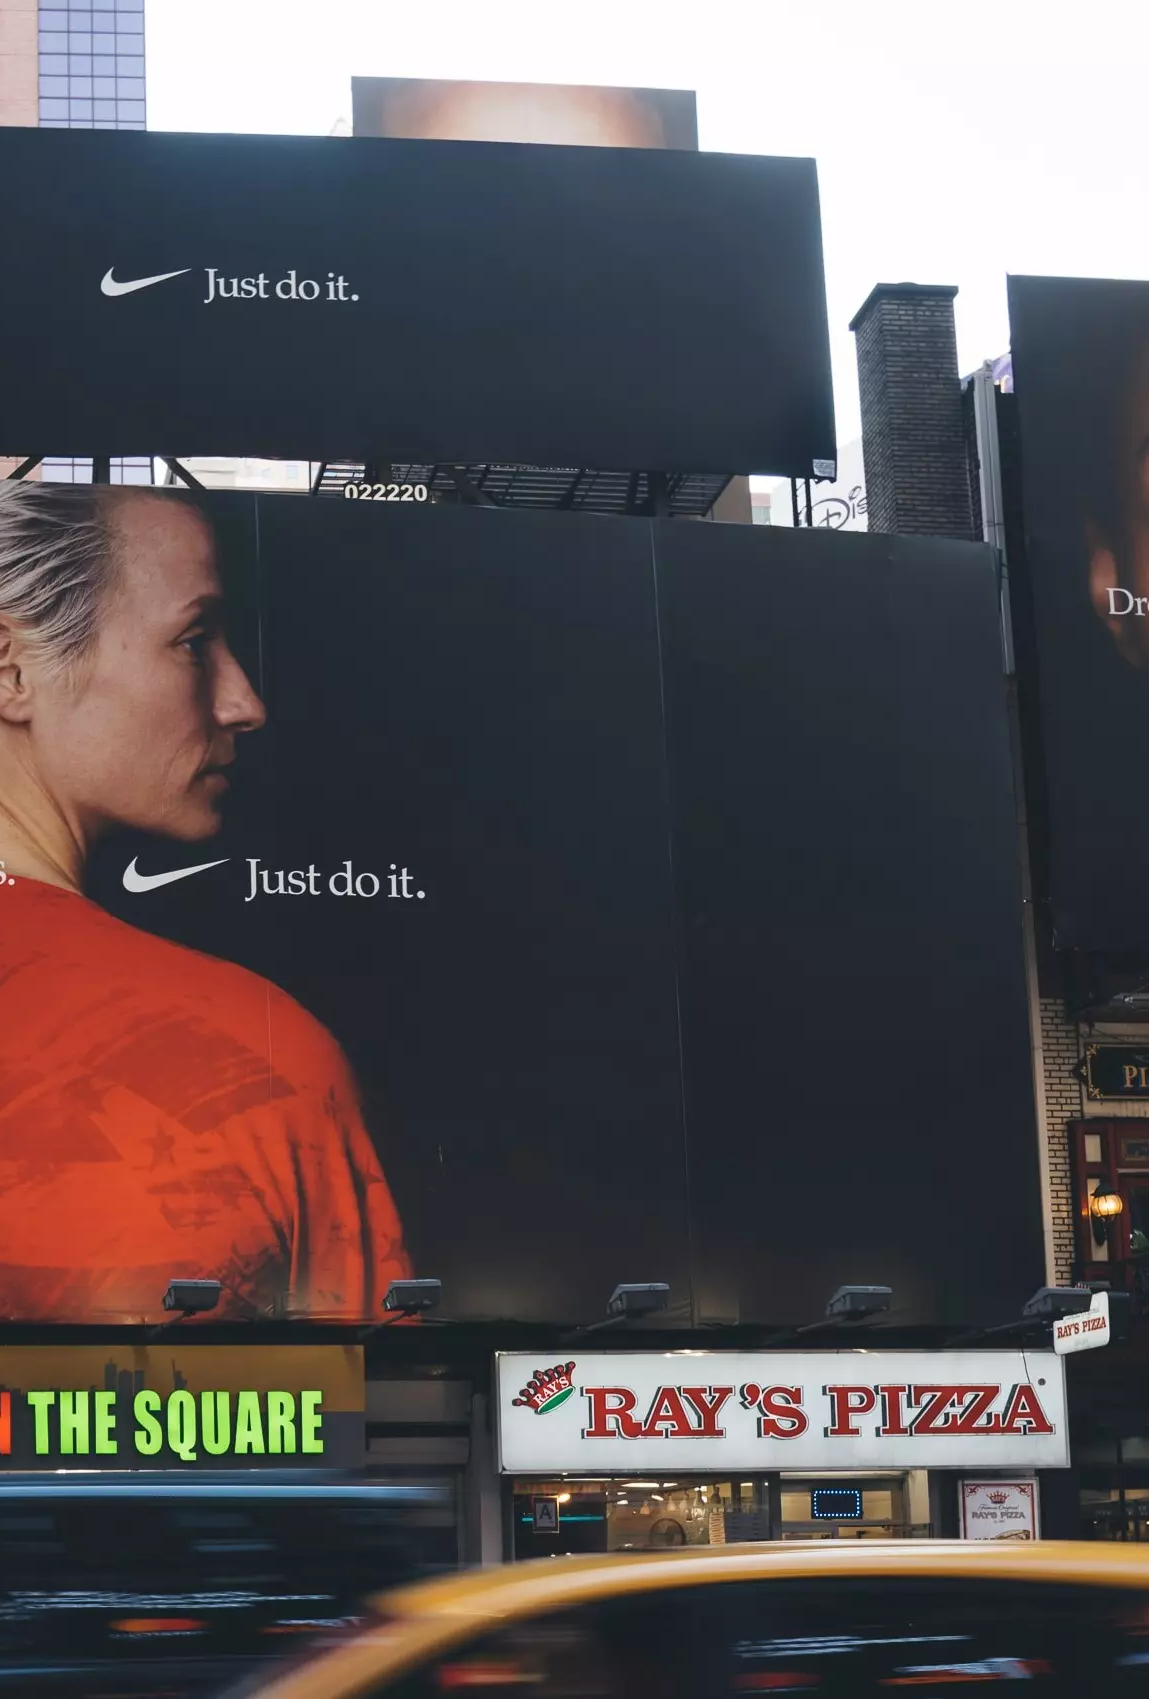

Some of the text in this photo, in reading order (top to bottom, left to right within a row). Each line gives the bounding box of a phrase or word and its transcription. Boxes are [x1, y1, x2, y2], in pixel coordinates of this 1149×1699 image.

[204, 268, 359, 304] Just do it.
[344, 484, 428, 502] 022220
[1105, 587, 1149, 616] Dr
[245, 858, 426, 902] Just do it.
[1057, 1316, 1107, 1339] RAY'S PIZZA
[533, 1376, 570, 1406] RAY'S
[27, 1391, 118, 1454] THE
[133, 1389, 324, 1461] SQUARE
[581, 1382, 1057, 1440] RAY'S PIZZA
[1000, 1511, 1026, 1519] PIZZA
